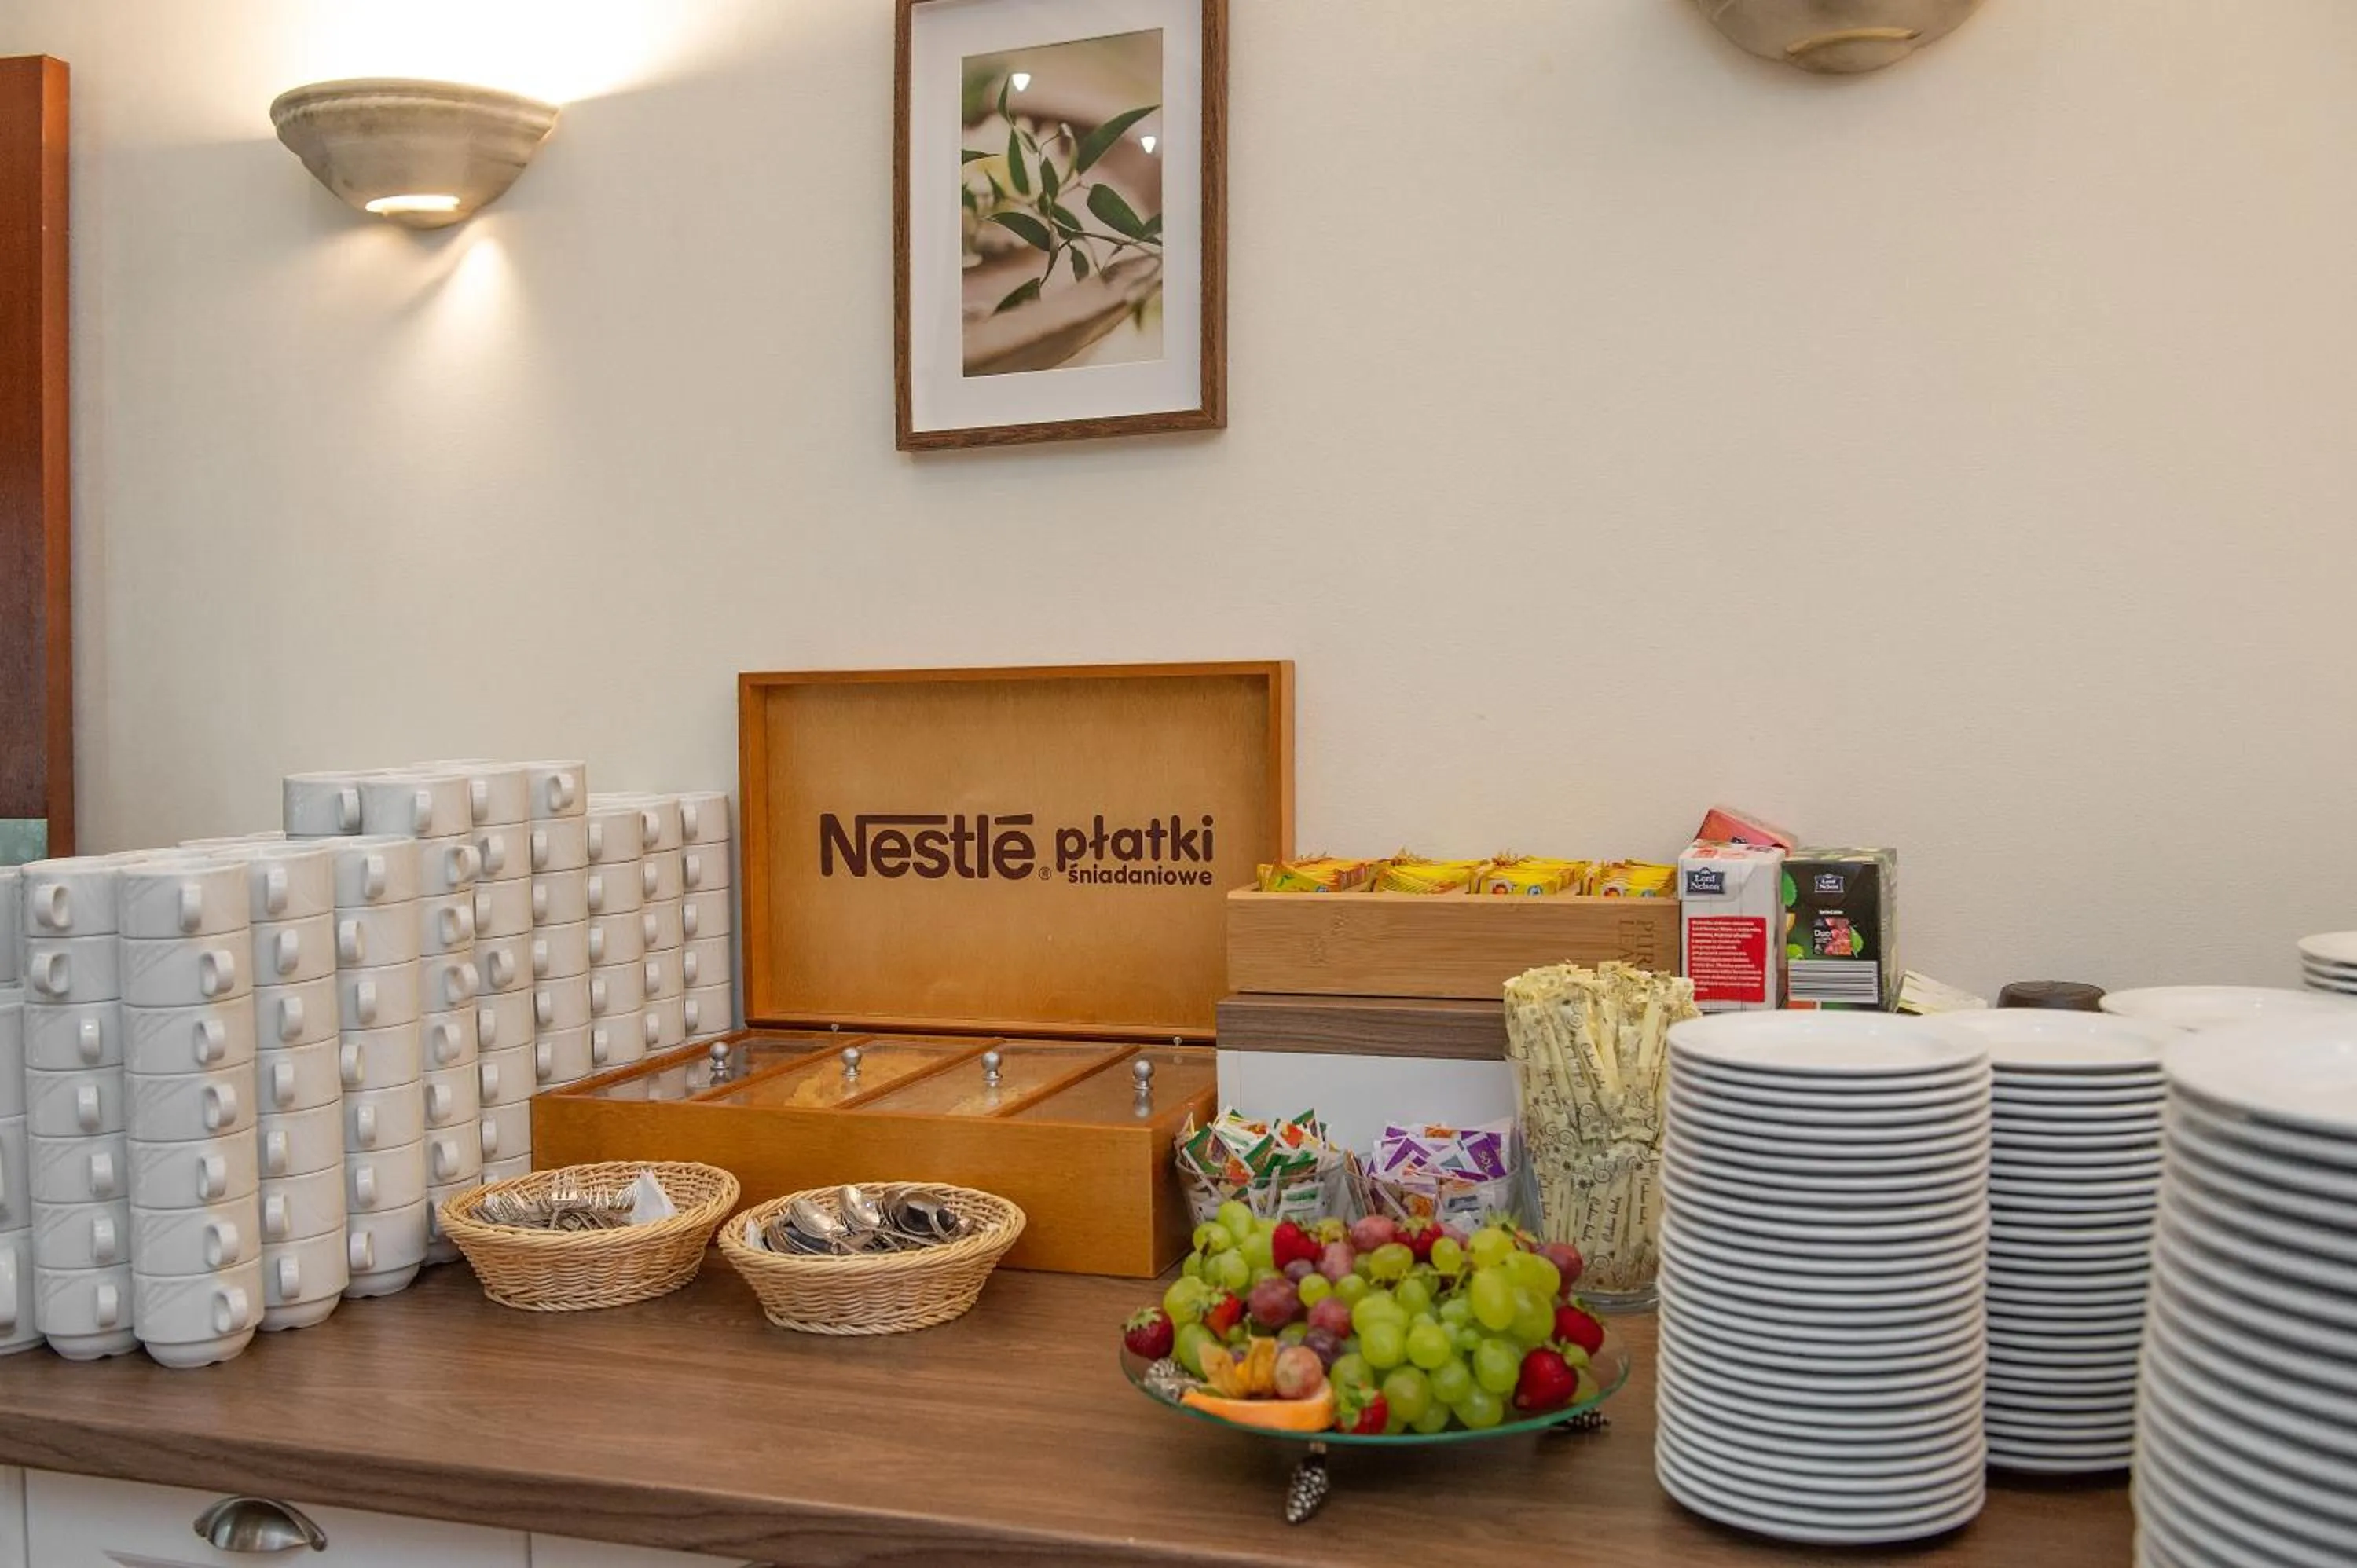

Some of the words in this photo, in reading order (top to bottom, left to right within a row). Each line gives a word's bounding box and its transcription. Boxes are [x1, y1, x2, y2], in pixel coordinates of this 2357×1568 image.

[820, 813, 1036, 880] Nestlé
[1056, 815, 1214, 872] płatki
[1068, 862, 1213, 886] śniadaniowe
[1690, 881, 1720, 892] Nelson
